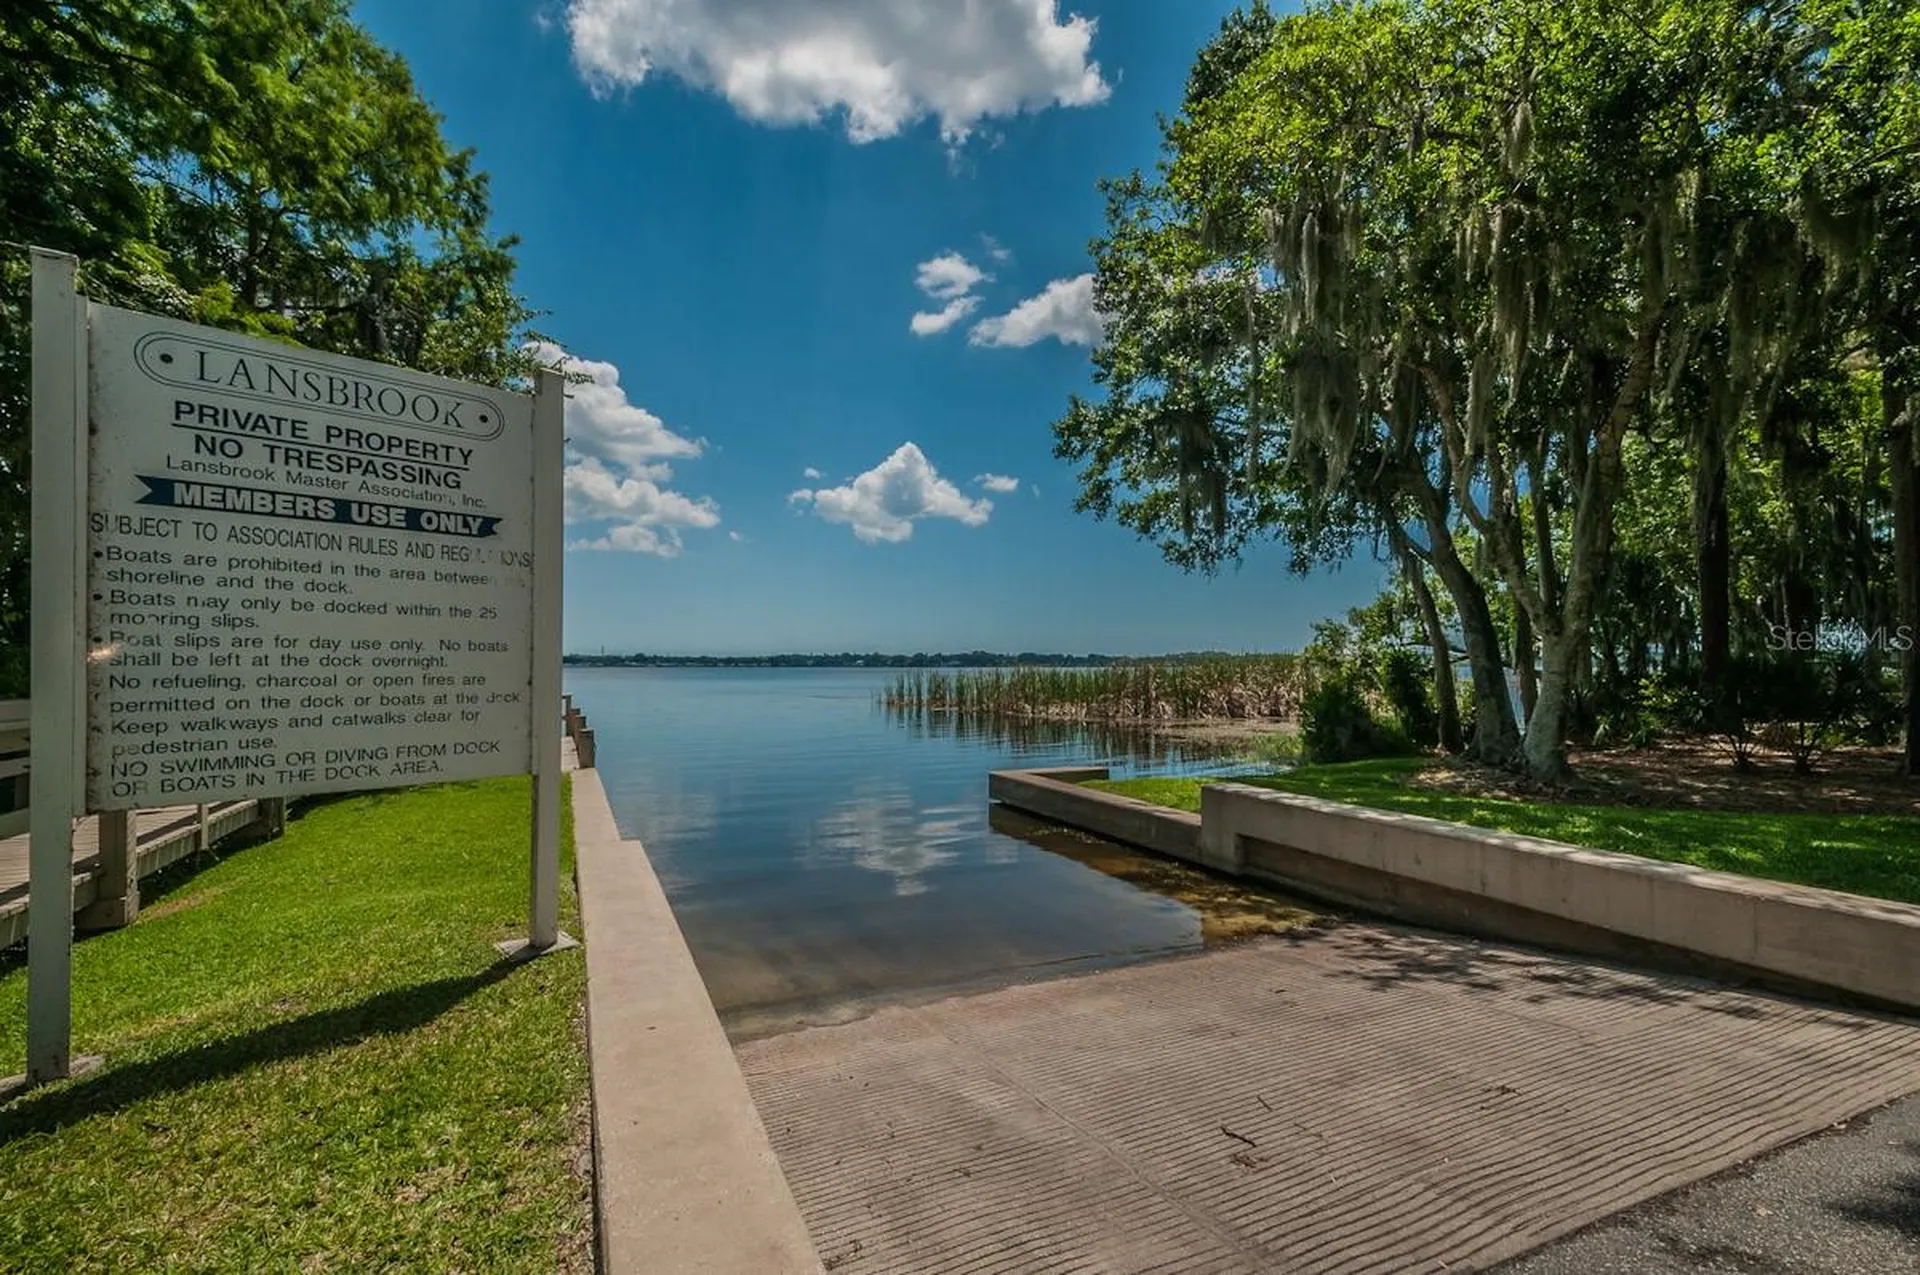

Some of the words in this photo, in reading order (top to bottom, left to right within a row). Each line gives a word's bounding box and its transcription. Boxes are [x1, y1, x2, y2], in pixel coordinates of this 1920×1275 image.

[195, 350, 463, 430] LANSBROOK
[174, 400, 308, 439] PRIVATE
[326, 425, 473, 466] PROPERTY
[194, 434, 243, 459] NO
[263, 444, 461, 489] TRESPASSING
[167, 453, 276, 481] Lansbrook
[286, 471, 348, 490] Master
[462, 493, 487, 509] Inc.
[174, 482, 336, 520] MEMBERS
[351, 502, 407, 527] USE
[420, 511, 484, 535] ONLY
[91, 512, 182, 538] SUBJECT
[192, 522, 218, 541] TO
[227, 525, 342, 550] ASSOCIATION
[350, 537, 398, 556] RULES
[405, 542, 434, 559] AND
[106, 545, 172, 564] Boats
[184, 553, 217, 567] are
[228, 556, 321, 574] prohibited
[330, 561, 345, 575] in
[354, 564, 381, 578] the
[390, 568, 426, 581] area
[107, 568, 205, 587] shoreline
[216, 575, 254, 589] and
[265, 576, 294, 592] the
[304, 579, 352, 593] dock.
[110, 589, 176, 606] Boats
[186, 594, 230, 611] may
[241, 597, 281, 613] only
[291, 598, 314, 612] be
[324, 600, 387, 615] docked
[396, 602, 441, 617] within
[449, 604, 472, 618] the
[479, 606, 497, 619] 25
[211, 614, 260, 630] slips.
[174, 632, 220, 650] slips
[231, 636, 263, 649] are
[274, 634, 299, 649] for
[309, 636, 342, 653] day
[351, 639, 381, 651] use
[439, 639, 461, 651] No
[468, 639, 508, 653] boats
[110, 652, 161, 667] shall
[172, 652, 198, 667] be
[210, 652, 240, 667] left
[251, 654, 269, 667] at
[280, 652, 309, 667] the
[319, 654, 362, 667] dock
[372, 655, 448, 671] overnight.
[109, 675, 141, 689] No
[256, 674, 337, 688] charcoal
[346, 676, 361, 687] or
[373, 675, 414, 690] open
[422, 673, 455, 686] fires
[462, 675, 486, 687] are
[110, 697, 215, 713] permitted
[225, 699, 250, 711] on
[261, 695, 290, 709] the
[300, 695, 344, 709] dock
[354, 696, 372, 707] or
[380, 694, 426, 707] boats
[433, 694, 448, 706] at
[456, 692, 480, 705] the
[111, 719, 168, 737] Keep
[181, 717, 279, 732] walkways
[288, 715, 323, 729] and
[331, 712, 406, 727] catwalks
[414, 710, 451, 724] clear
[461, 709, 480, 722] for
[110, 760, 148, 779] NO
[160, 753, 276, 775] SWIMMING
[286, 751, 316, 767] OR
[325, 747, 389, 764] DIVING
[396, 743, 447, 759] FROM
[454, 740, 500, 756] DOCK
[112, 740, 228, 759] pedestrian
[160, 774, 236, 793] BOATS
[246, 772, 265, 786] IN
[275, 768, 315, 784] THE
[325, 765, 381, 780] DOCK
[390, 760, 444, 776] AREA.
